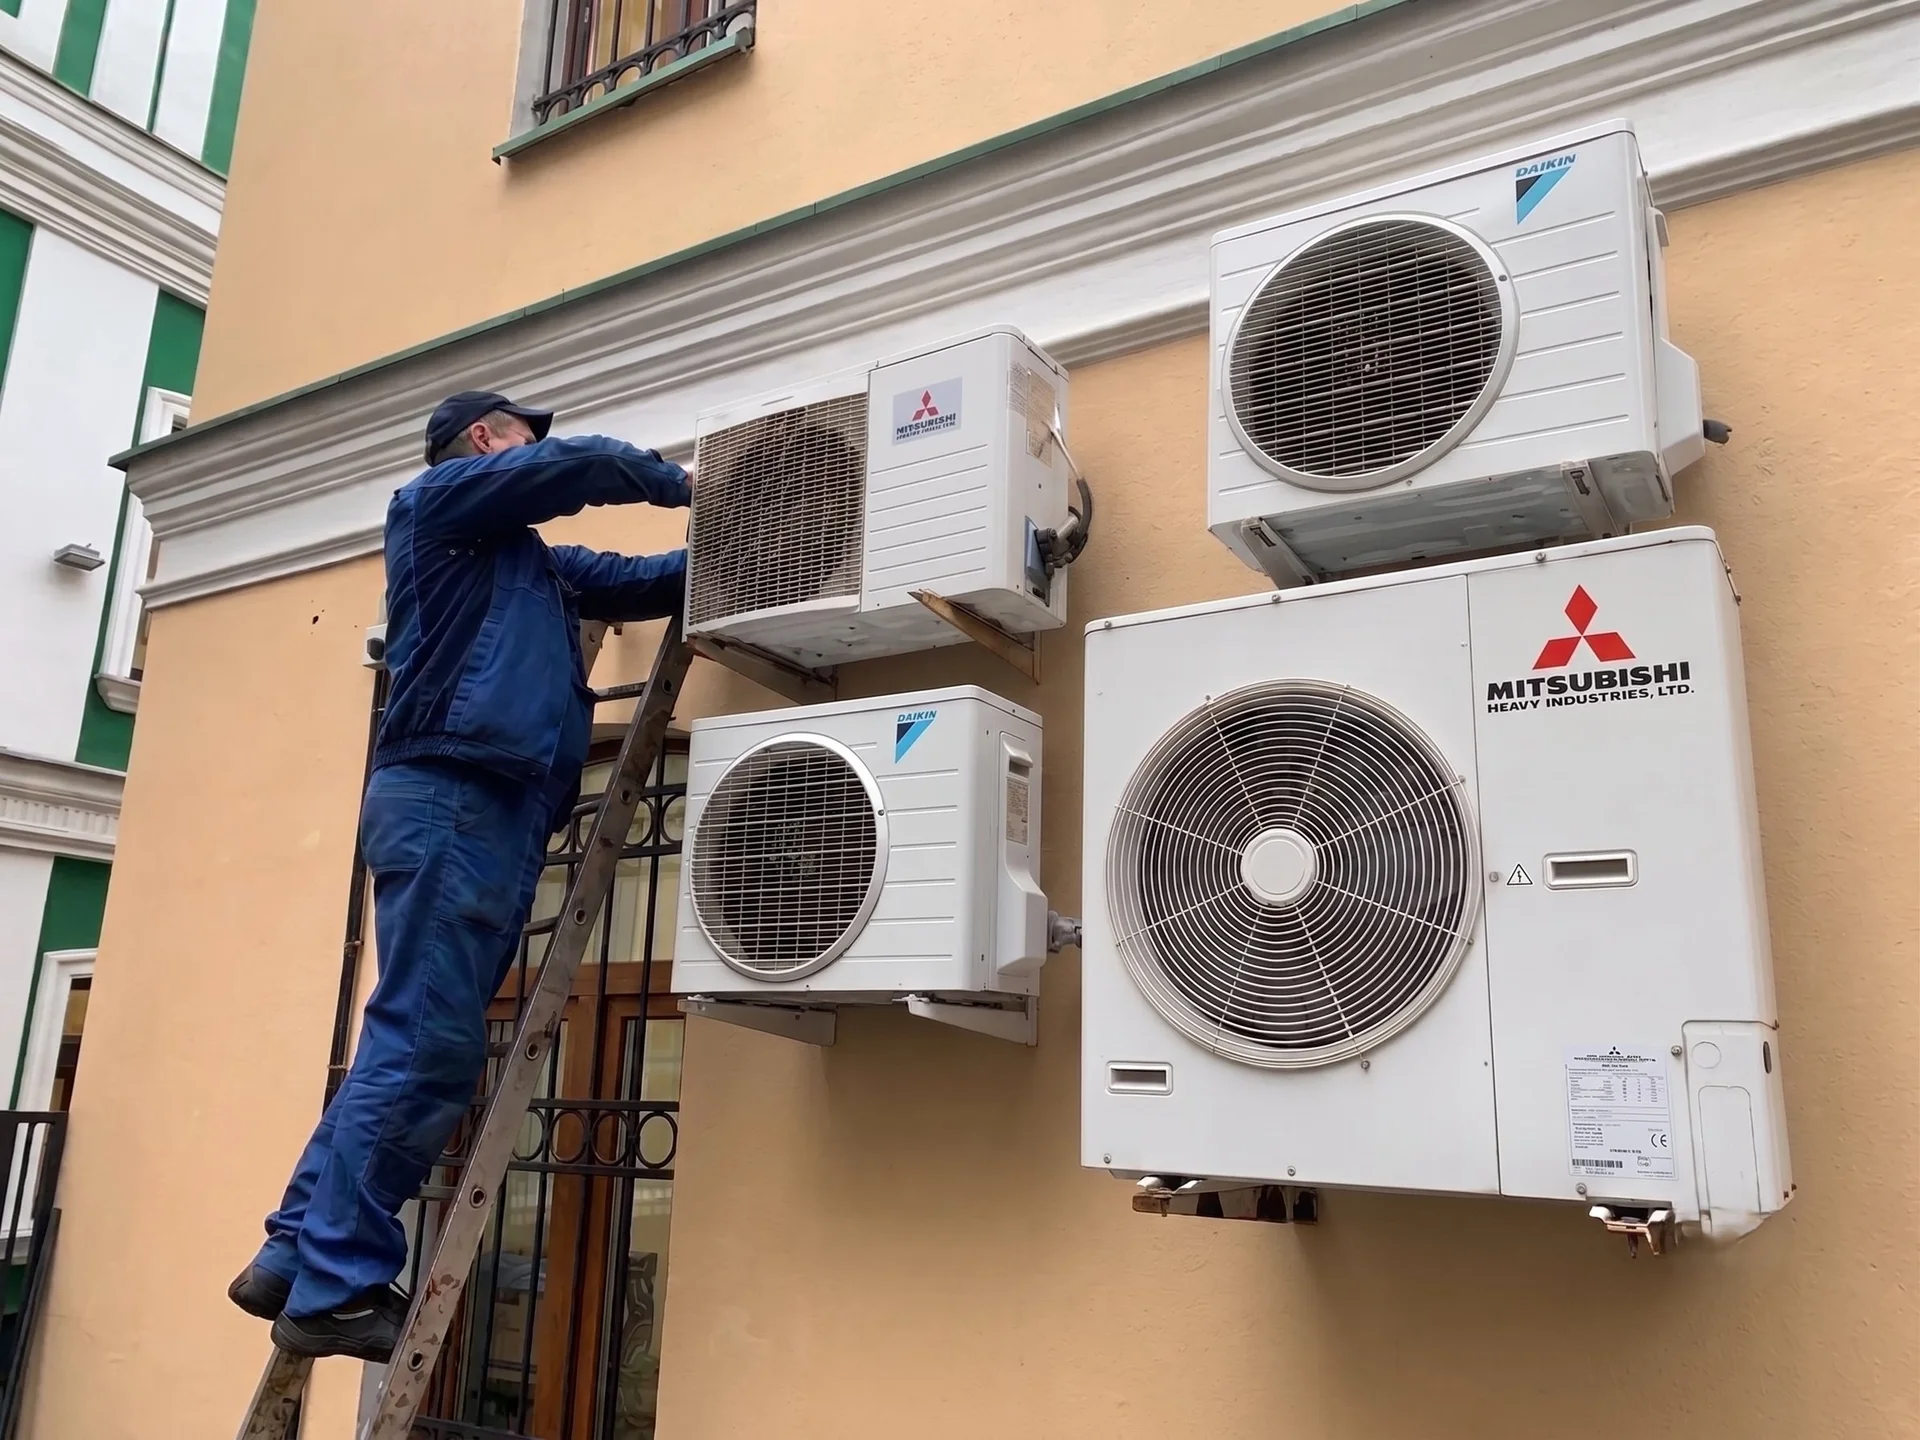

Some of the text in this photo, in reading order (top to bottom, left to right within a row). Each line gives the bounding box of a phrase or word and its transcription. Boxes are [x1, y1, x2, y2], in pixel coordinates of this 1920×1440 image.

[1516, 154, 1576, 177] DAIKIN
[1487, 661, 1691, 701] MITSUBISHI
[1487, 684, 1694, 714] HEAVY INDUSTRIES, LTD.
[897, 710, 937, 722] DAIKIN
